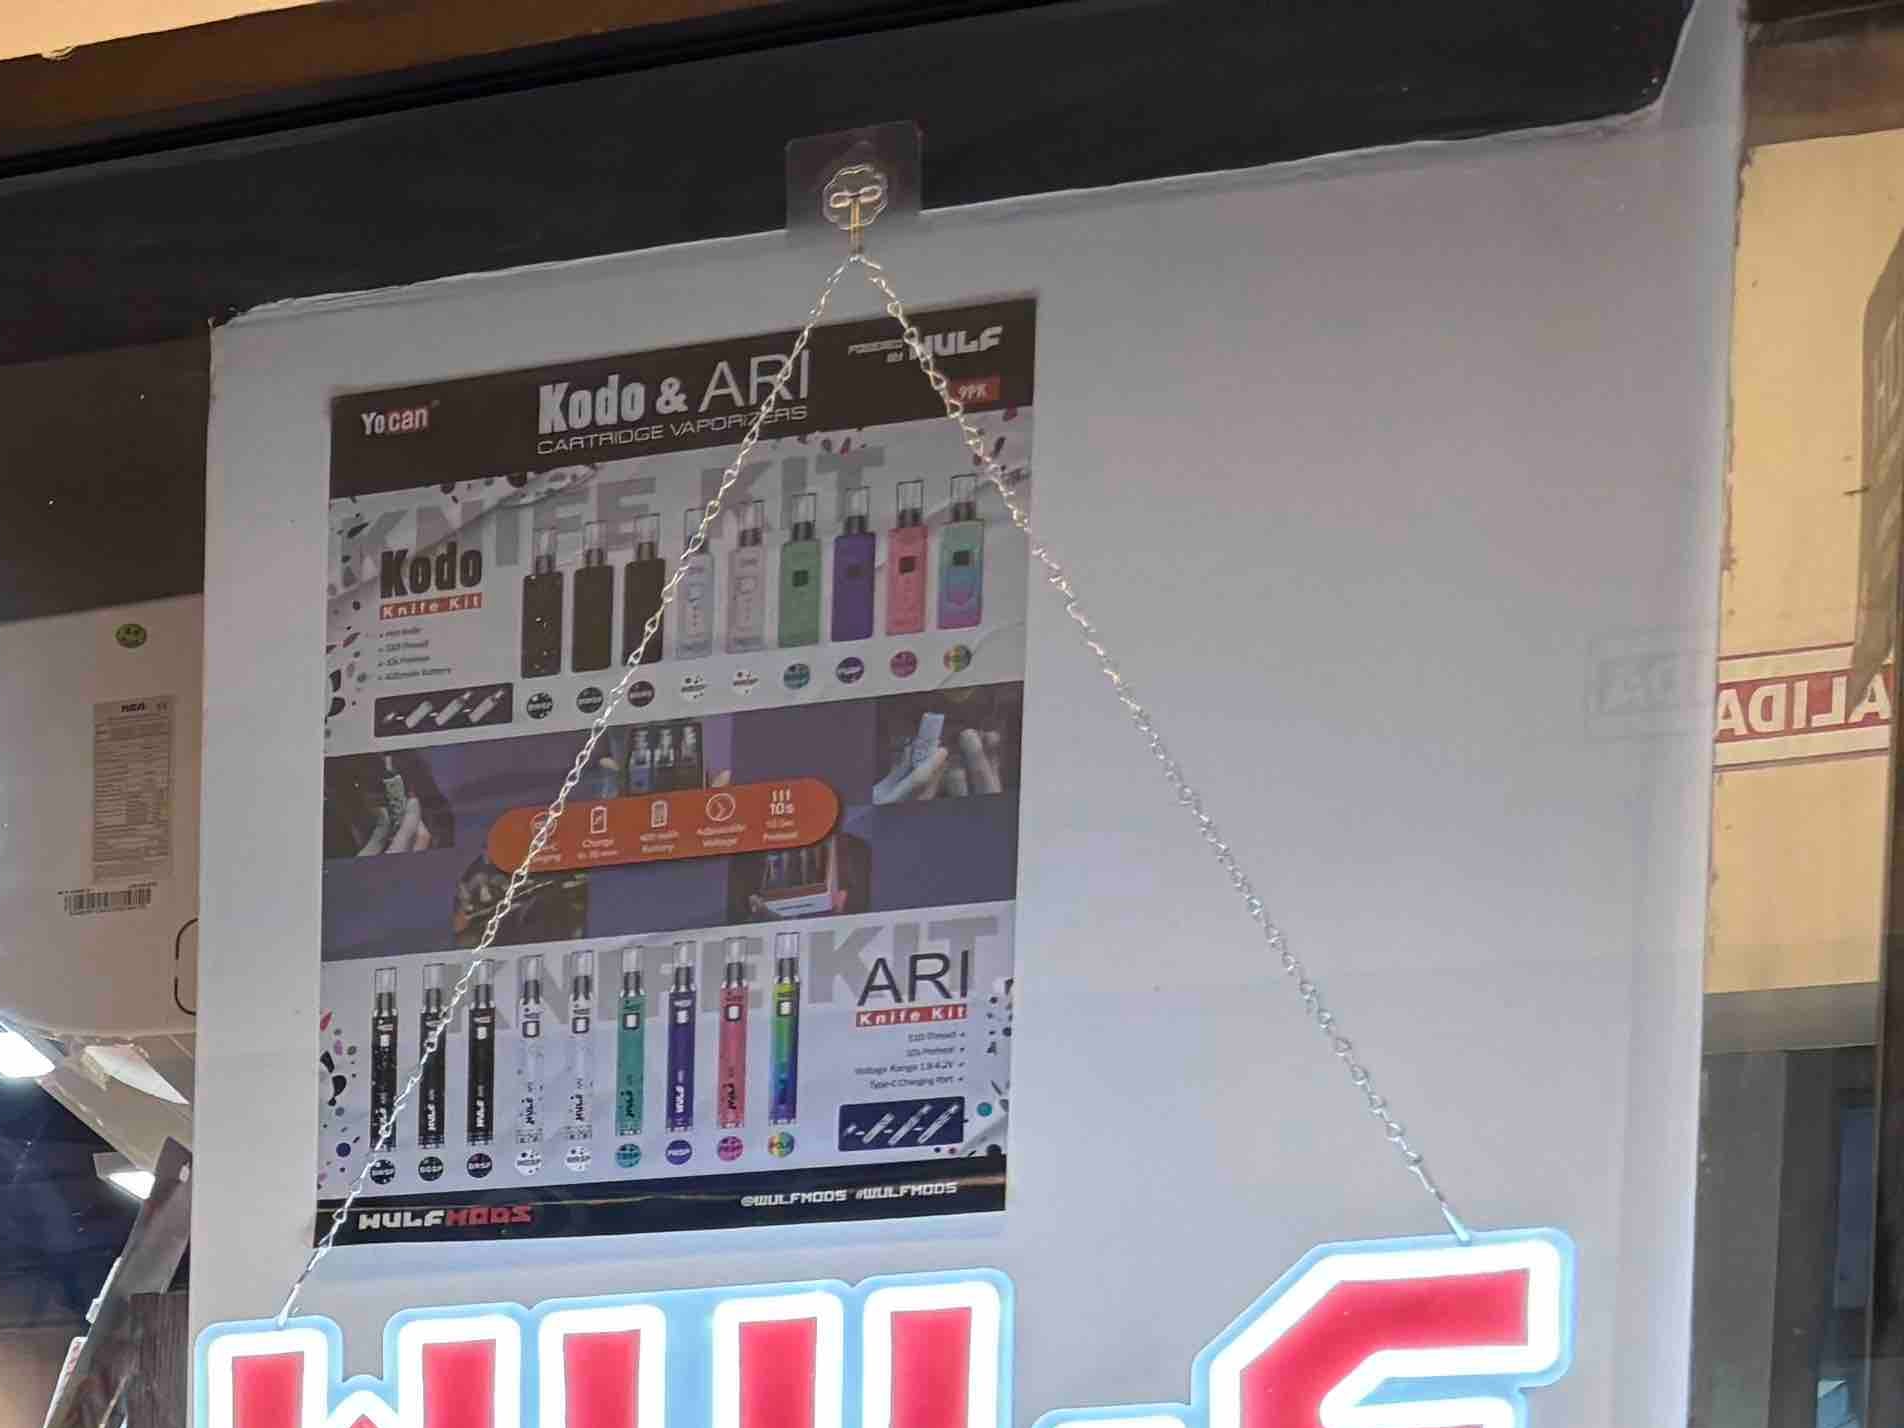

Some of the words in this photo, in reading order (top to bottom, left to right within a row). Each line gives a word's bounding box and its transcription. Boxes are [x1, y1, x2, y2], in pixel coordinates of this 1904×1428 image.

[537, 375, 645, 435] Kodo
[657, 376, 688, 415] &
[700, 350, 810, 411] ARI
[360, 407, 428, 435] Yocan
[537, 424, 663, 455] CARTRIDGE
[670, 405, 807, 439] VAPORIZERS
[380, 541, 483, 599] Kodo
[383, 601, 442, 618] Knife
[449, 595, 482, 611] Kit
[857, 950, 969, 1006] ARI
[859, 1010, 922, 1025] Knife
[932, 1005, 965, 1020] Kit
[740, 1186, 848, 1209] @WULFMODS
[854, 1180, 958, 1201] #WULFMODS
[359, 1206, 533, 1232] WULFMODS
